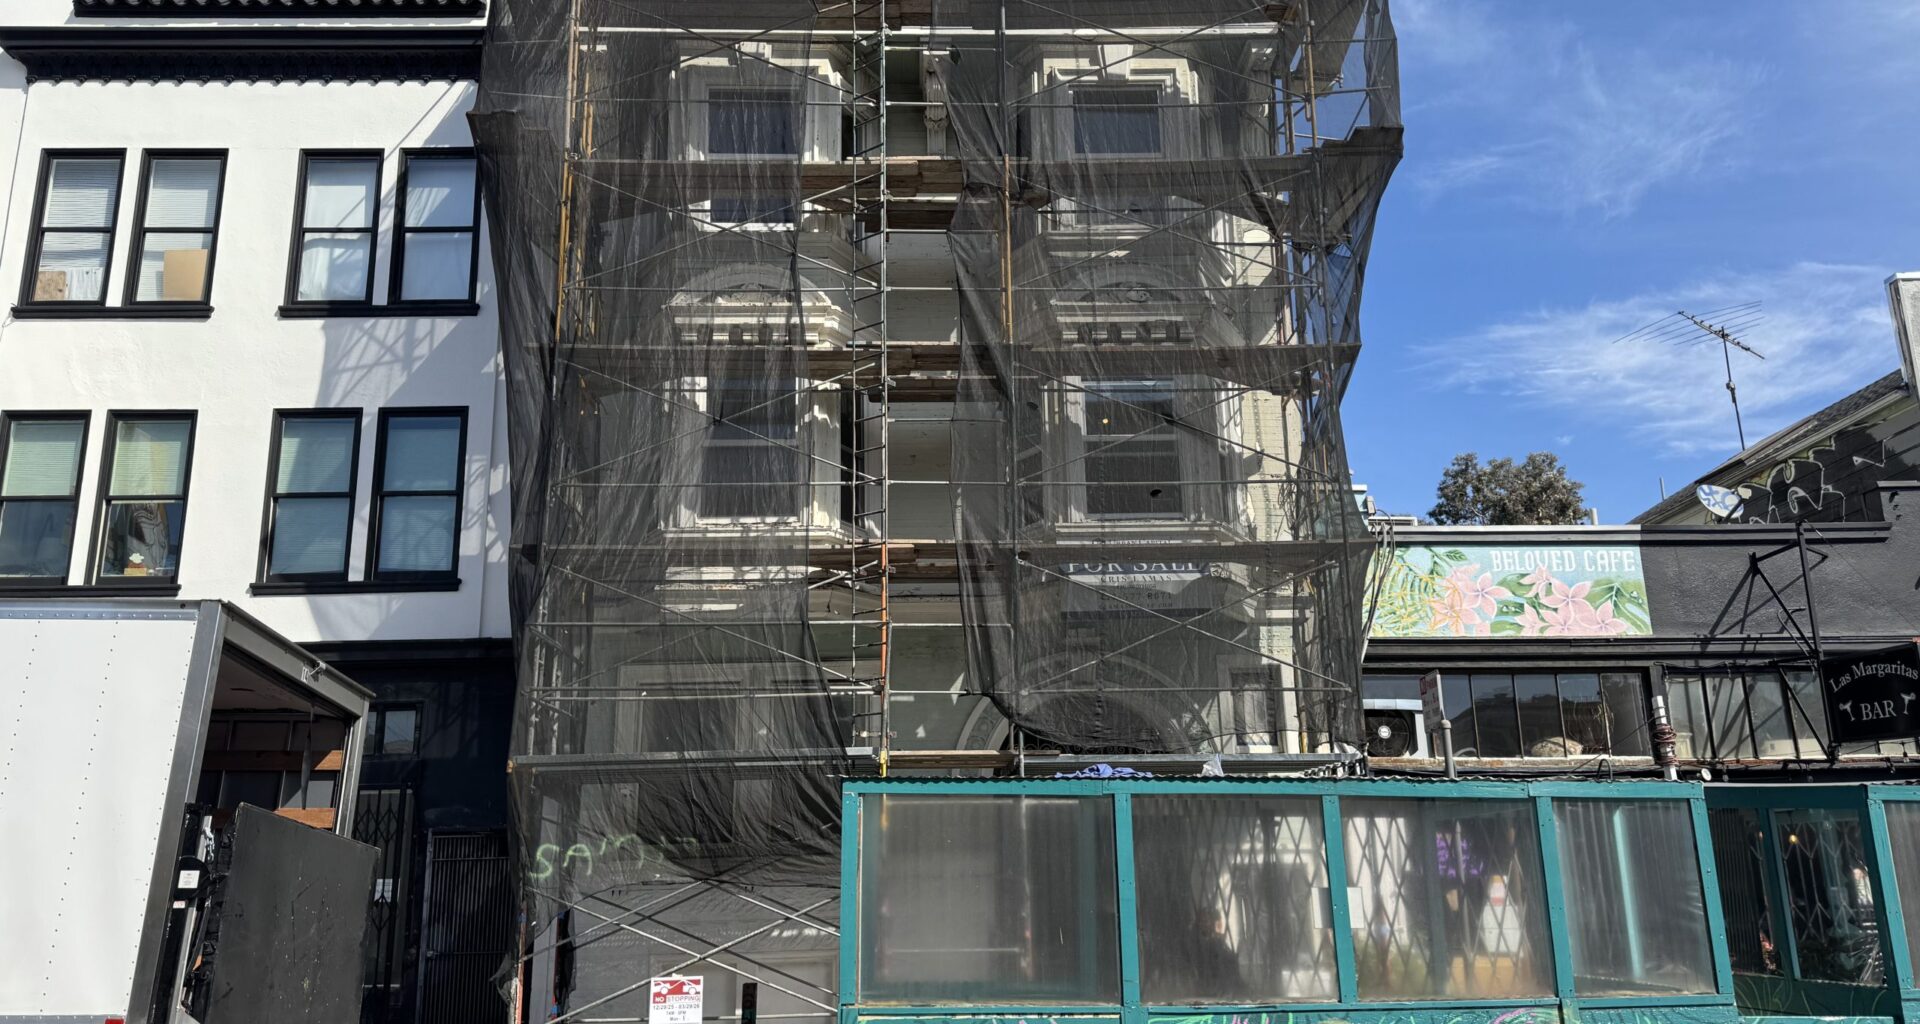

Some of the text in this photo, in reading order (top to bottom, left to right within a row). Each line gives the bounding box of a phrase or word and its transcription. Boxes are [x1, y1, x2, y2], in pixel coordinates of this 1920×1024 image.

[1068, 562, 1124, 573] FOR
[1490, 550, 1635, 572] BELOVED CAFE
[1829, 661, 1919, 693] Las Margaritas
[1860, 700, 1897, 720] BAR
